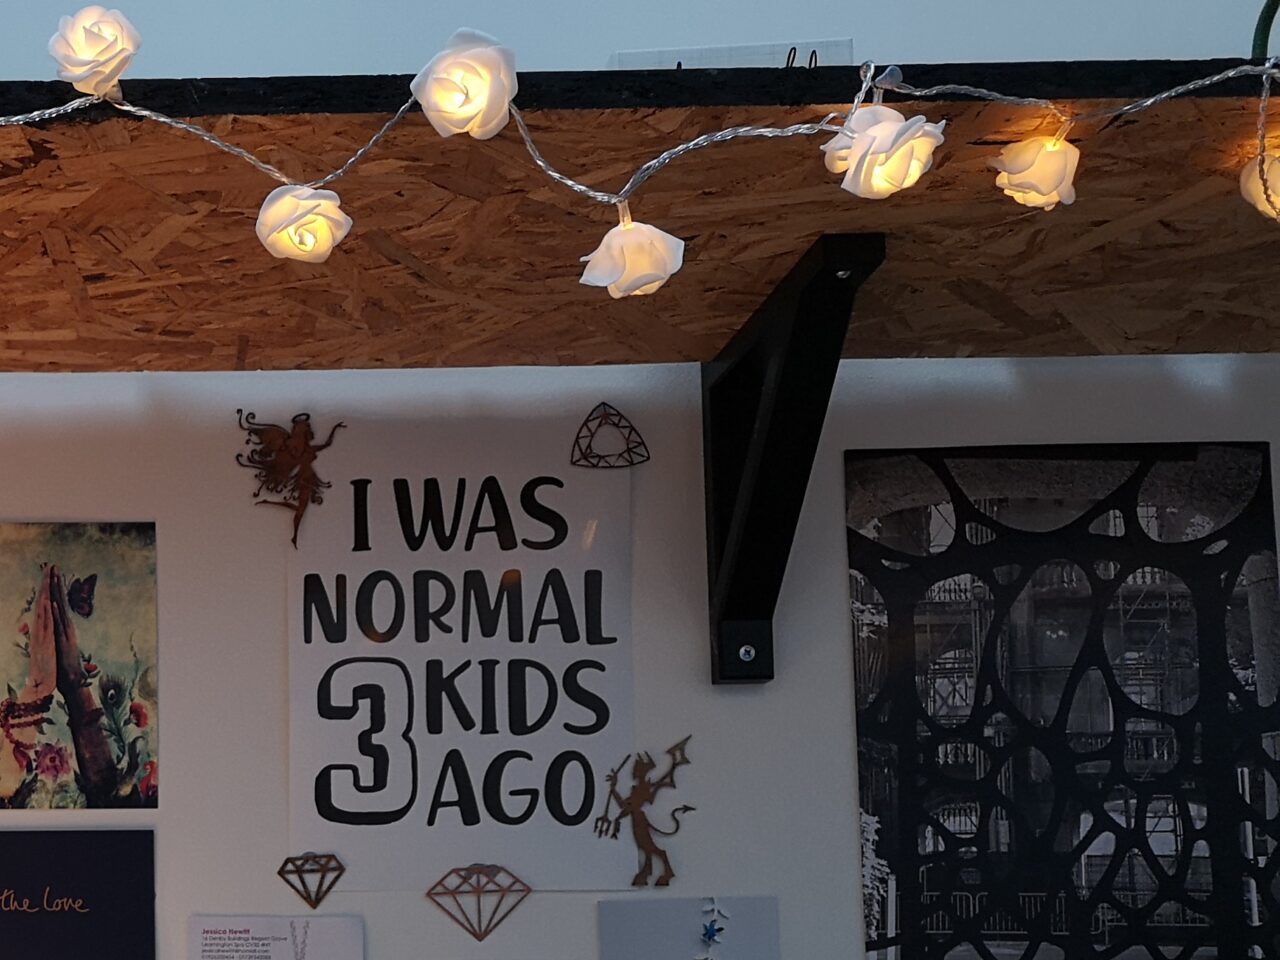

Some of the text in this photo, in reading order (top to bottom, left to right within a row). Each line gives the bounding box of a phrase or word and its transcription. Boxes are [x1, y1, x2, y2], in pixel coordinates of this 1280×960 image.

[350, 475, 569, 552] I WAS
[303, 567, 618, 646] NORMAL
[314, 656, 611, 826] 3 KIDS
[427, 748, 596, 827] AGO
[43, 886, 90, 912] love
